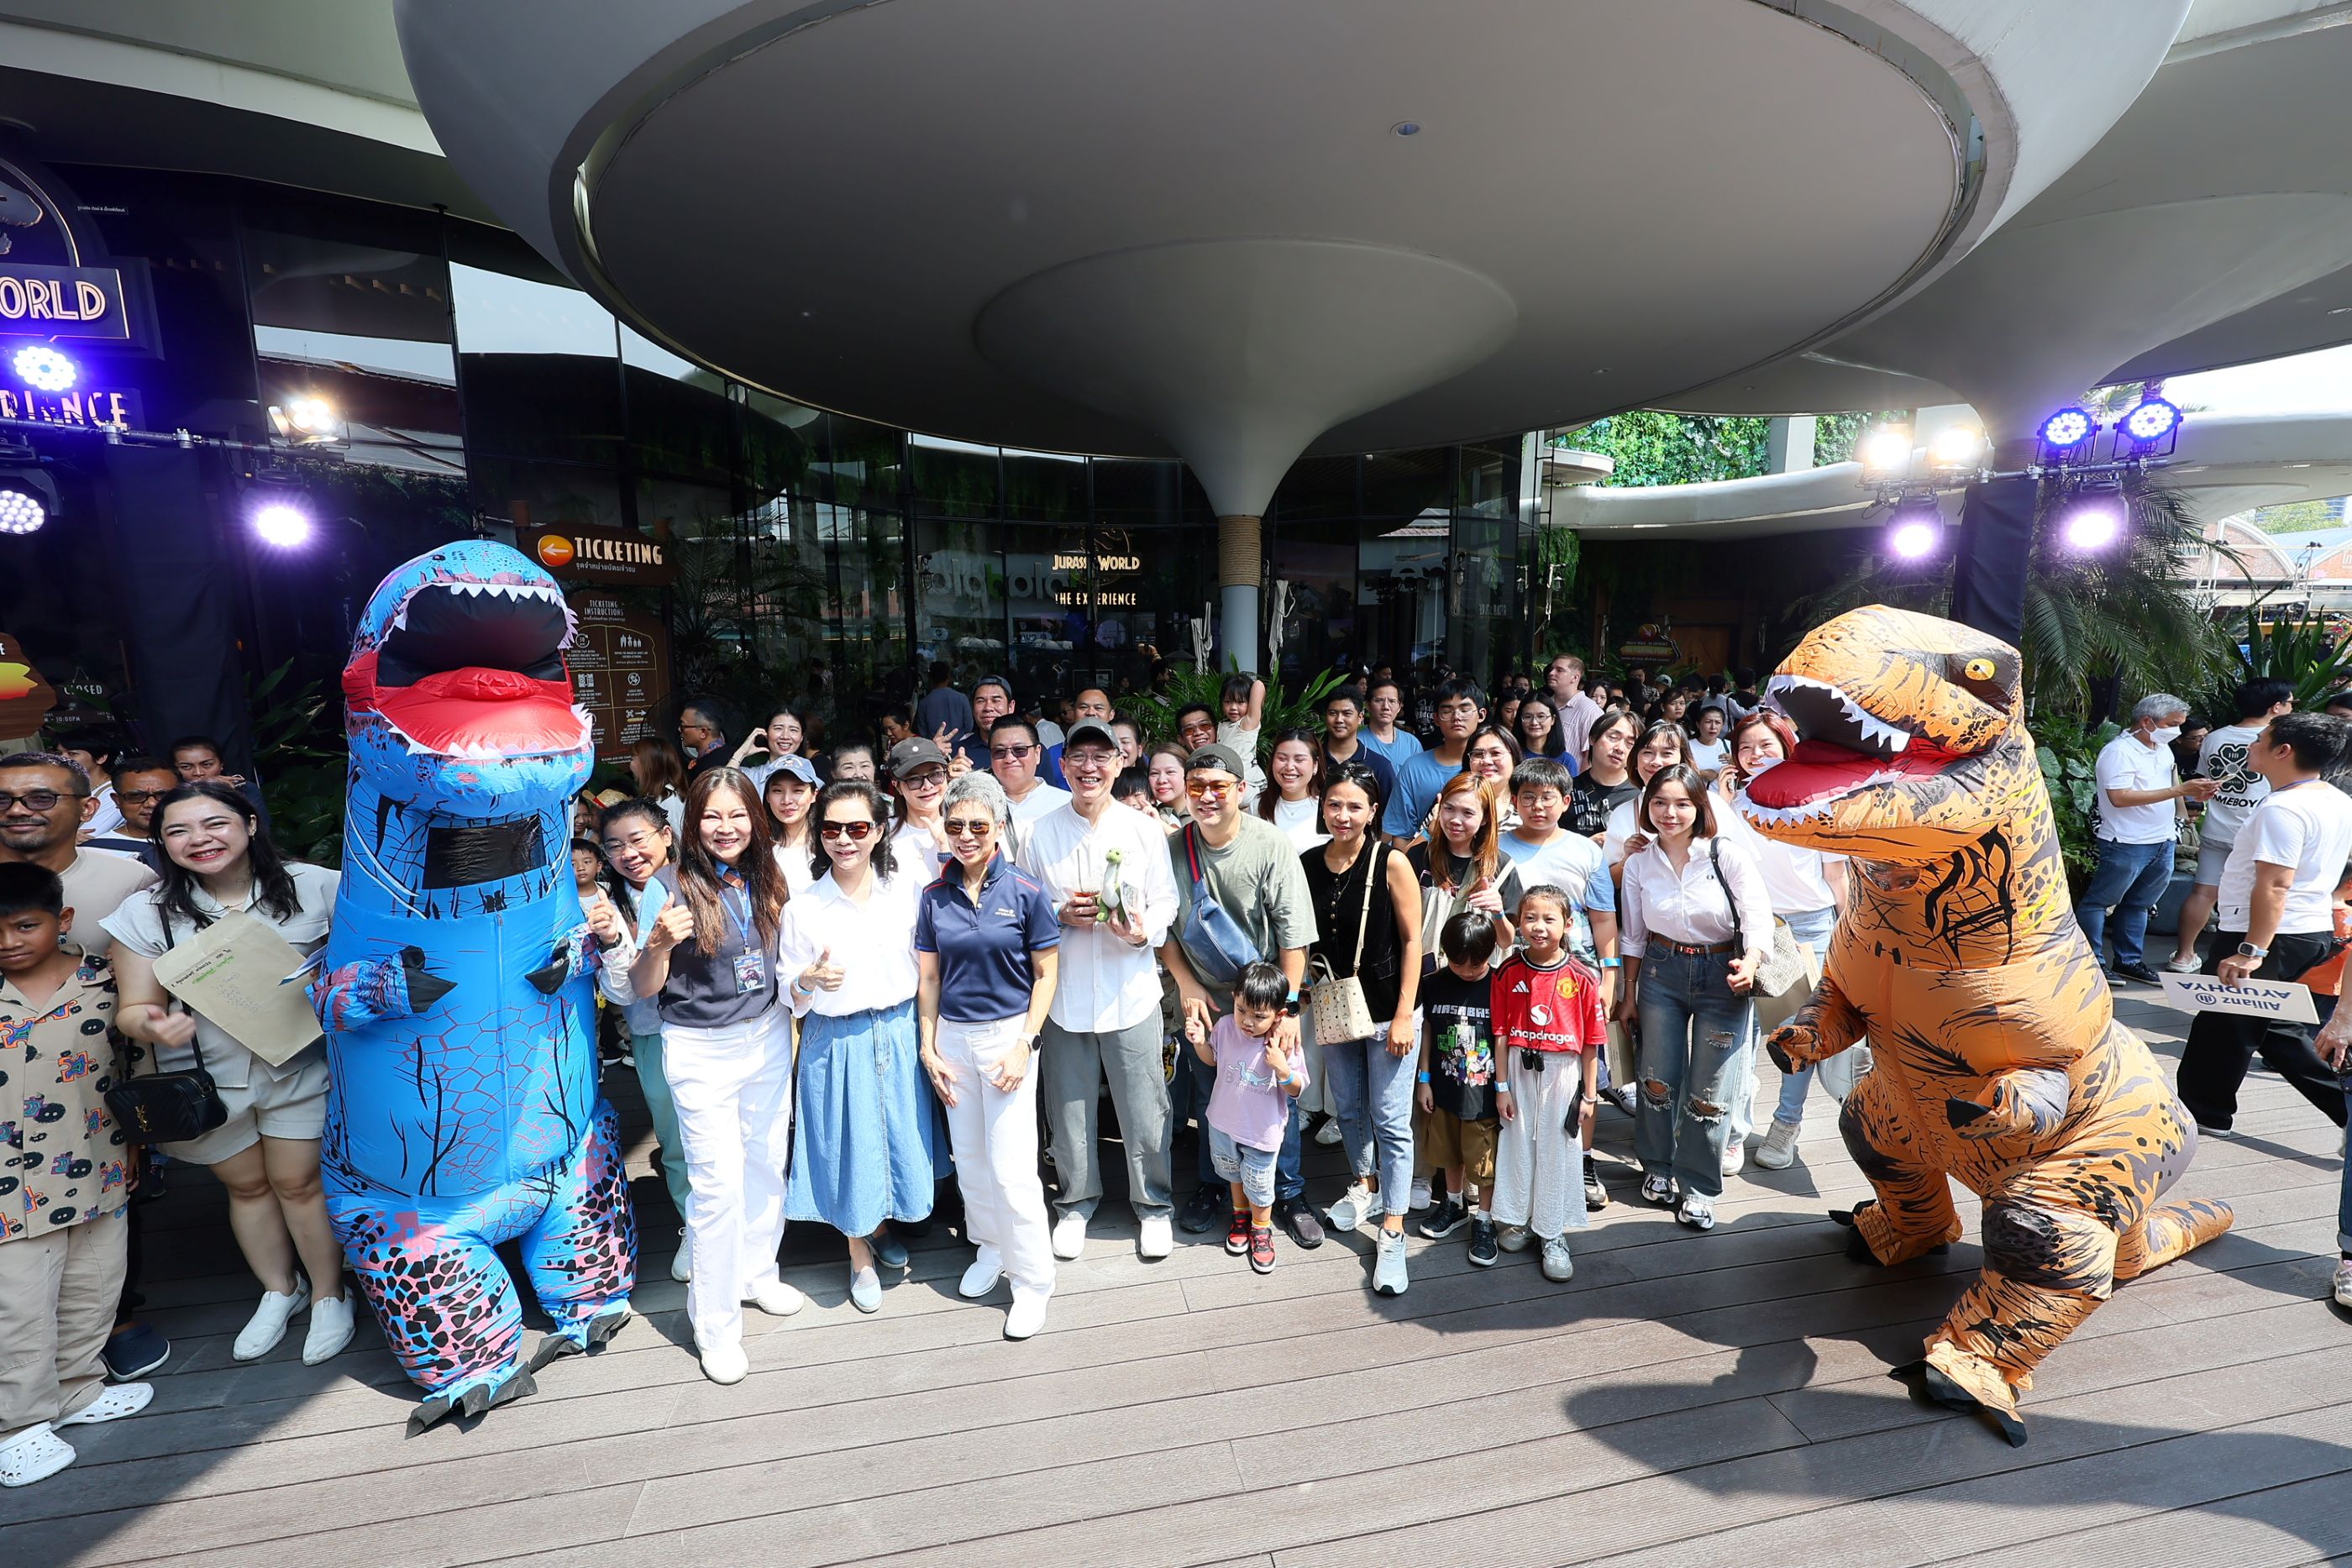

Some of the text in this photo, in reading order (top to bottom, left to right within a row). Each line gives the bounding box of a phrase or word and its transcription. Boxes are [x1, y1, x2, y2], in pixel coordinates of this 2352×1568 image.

[575, 537, 663, 565] TICKETING
[1052, 554, 1140, 570] JURASS WORLD
[589, 600, 618, 608] TICKETING
[1076, 592, 1137, 606] EXERIENCE
[584, 607, 624, 616] INSTRUCTIONS
[64, 684, 102, 695] COSED
[1574, 802, 1585, 815] in
[744, 979, 758, 989] VIP
[2177, 981, 2292, 999] AYUDHYA
[2221, 996, 2281, 1010] Allianz
[1510, 1025, 1576, 1045] Snapdragon
